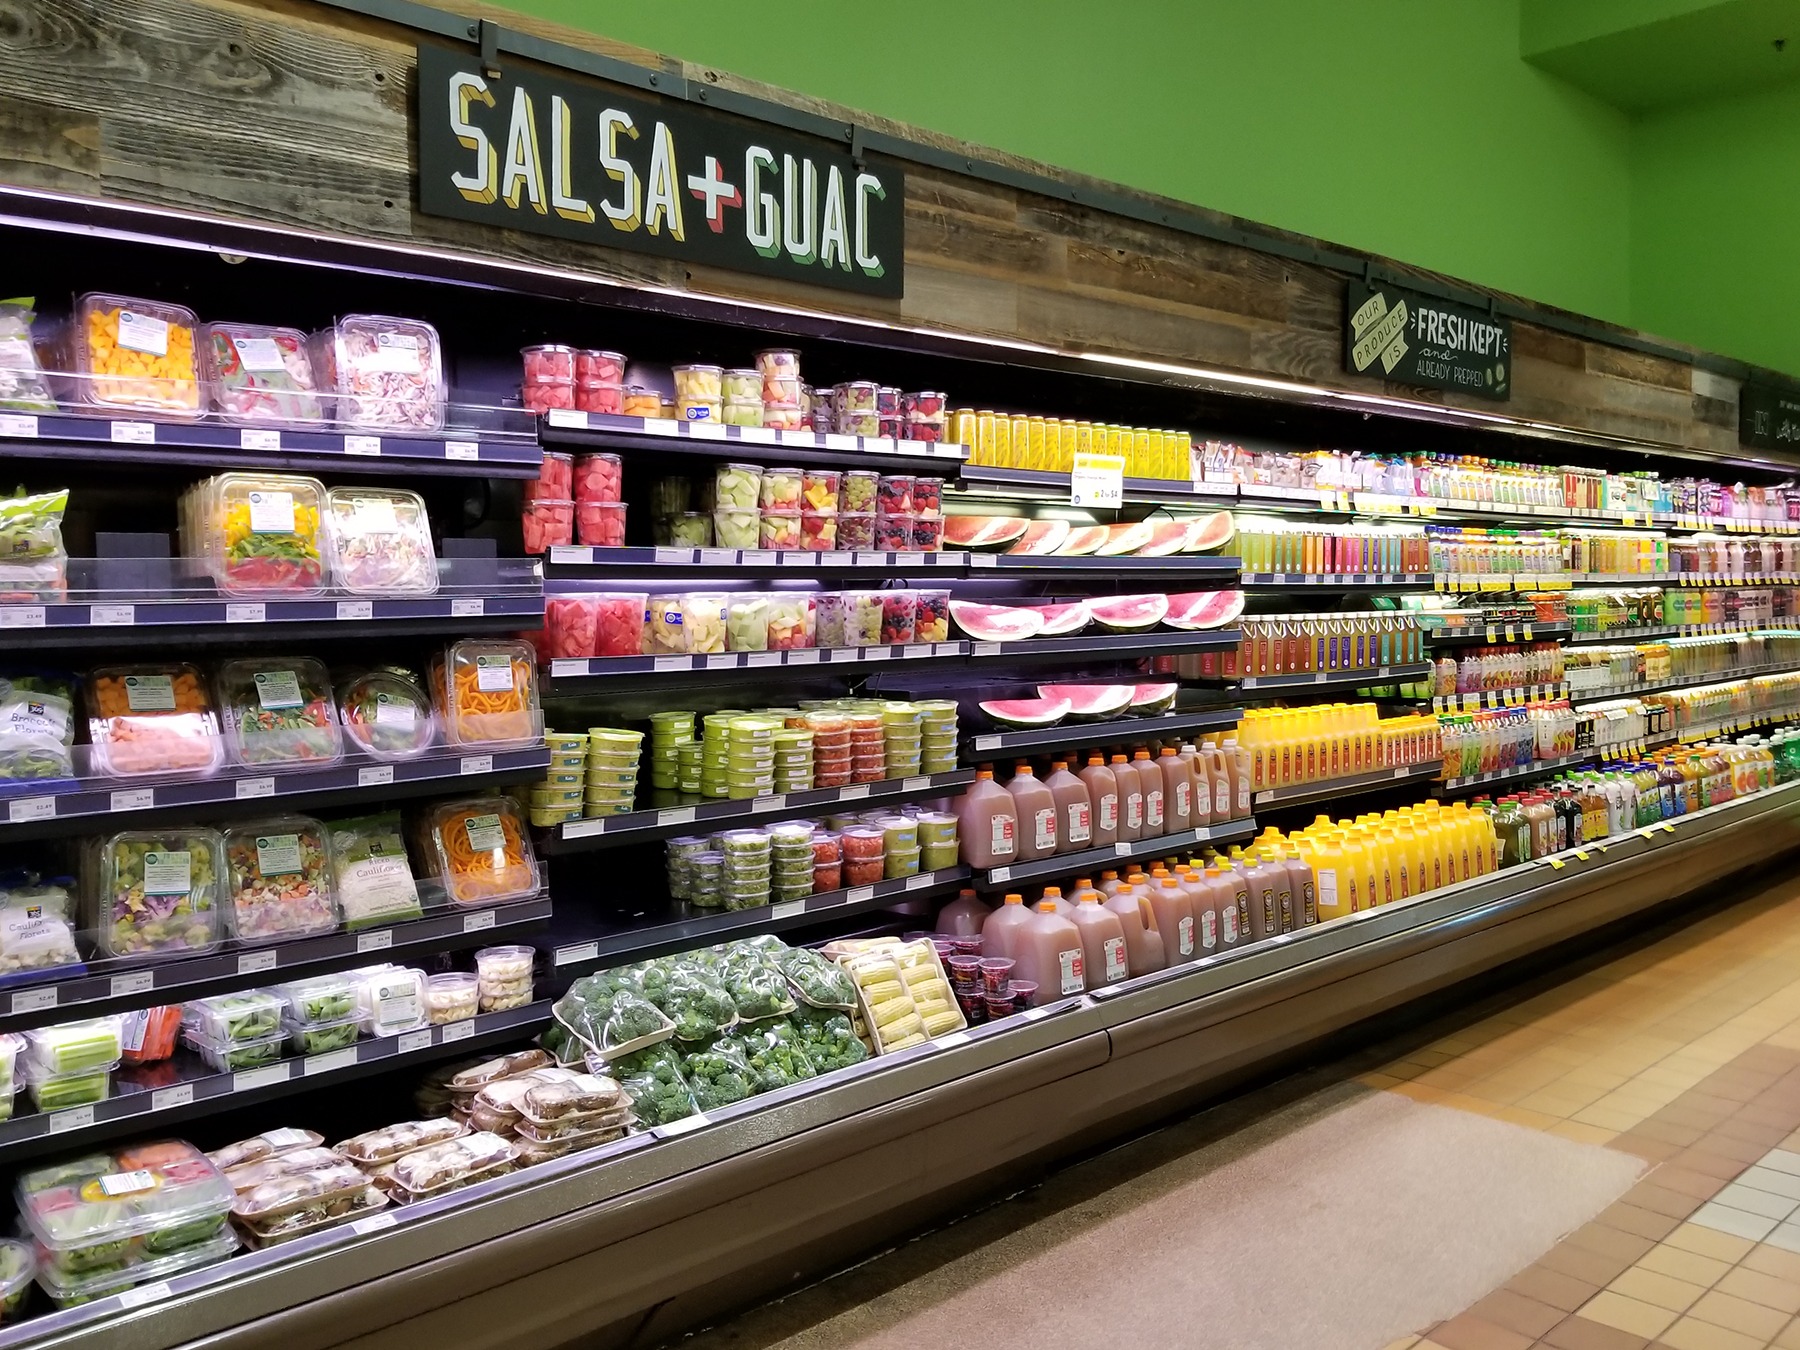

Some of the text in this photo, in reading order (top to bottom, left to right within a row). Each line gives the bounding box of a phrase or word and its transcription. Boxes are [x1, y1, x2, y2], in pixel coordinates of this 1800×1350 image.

[1357, 299, 1380, 326] OUR
[1356, 307, 1405, 365] PRODUCE
[1417, 307, 1503, 358] FRESH KEPT
[1388, 344, 1401, 364] IS
[1419, 347, 1458, 361] and
[1416, 359, 1484, 388] ALREADY PREPPED
